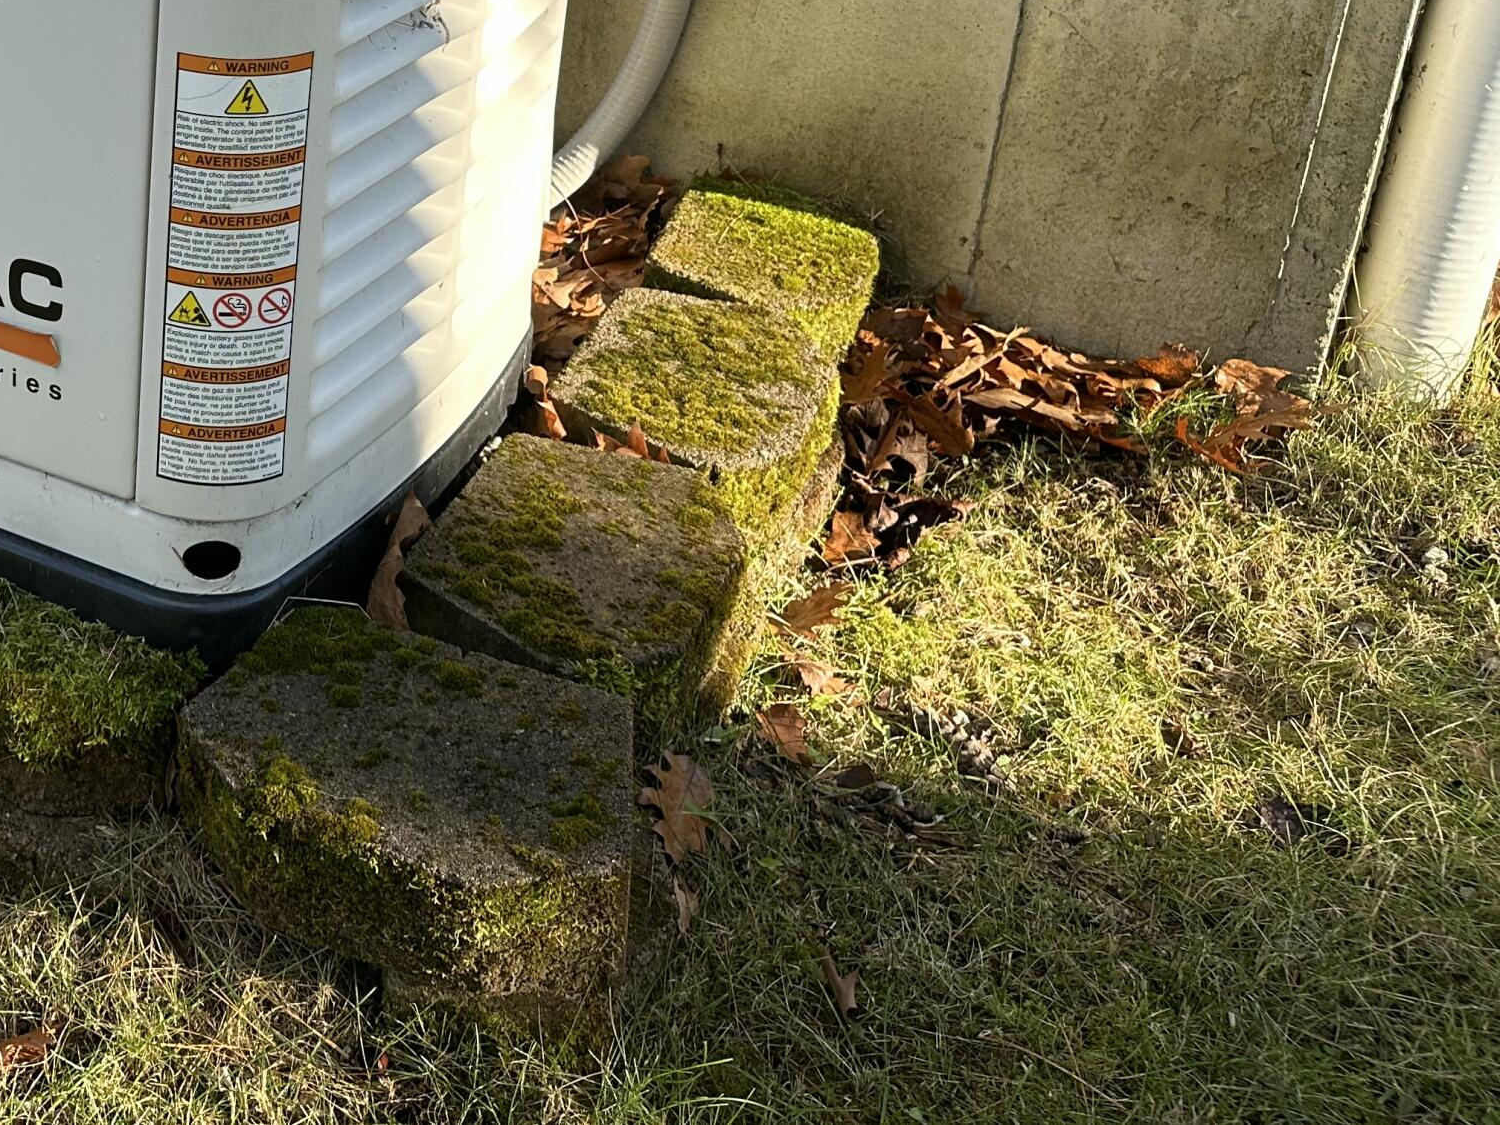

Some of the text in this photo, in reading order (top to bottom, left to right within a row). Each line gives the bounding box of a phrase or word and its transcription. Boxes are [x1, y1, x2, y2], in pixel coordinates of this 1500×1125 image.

[225, 61, 289, 73] WARNING
[177, 131, 199, 139] engine
[201, 134, 235, 142] generator
[283, 131, 295, 140] only
[255, 127, 273, 135] panel
[176, 139, 273, 151] operated by qualified service
[196, 150, 302, 167] AVERTISSEMENT
[175, 166, 196, 176] Risque
[174, 182, 201, 192] Panneau
[173, 190, 196, 198] destiné
[240, 194, 277, 202] uniquement
[173, 198, 204, 208] personnel
[200, 211, 290, 226] ADVERTENCIA
[172, 226, 192, 236] Riesgo
[204, 232, 234, 240] descarga
[171, 242, 190, 250] control
[192, 238, 204, 246] que
[239, 239, 259, 247] pueda
[184, 253, 214, 261] destinado
[181, 260, 209, 269] personal
[213, 274, 273, 286] WARNING
[167, 328, 198, 339] Explosion
[166, 344, 184, 352] strike
[167, 336, 187, 345] severe
[190, 339, 207, 349] injury
[166, 352, 187, 361] vicinity
[211, 357, 234, 367] battery
[184, 364, 286, 381] AVERTISSEMENT
[165, 379, 200, 391] L'explosion
[268, 380, 280, 389] peut
[164, 389, 186, 397] causer
[235, 393, 255, 401] graves
[164, 404, 191, 413] allumette
[235, 400, 257, 409] allumer
[163, 411, 190, 421] proximité
[188, 424, 275, 439] ADVERTENCIA
[171, 439, 201, 450] explosión
[162, 445, 180, 454] puede
[182, 449, 205, 457] causar
[207, 450, 226, 458] daños
[228, 450, 252, 458] severos
[168, 461, 183, 469] haga
[185, 465, 210, 473] chispas
[232, 464, 259, 472] vecindad
